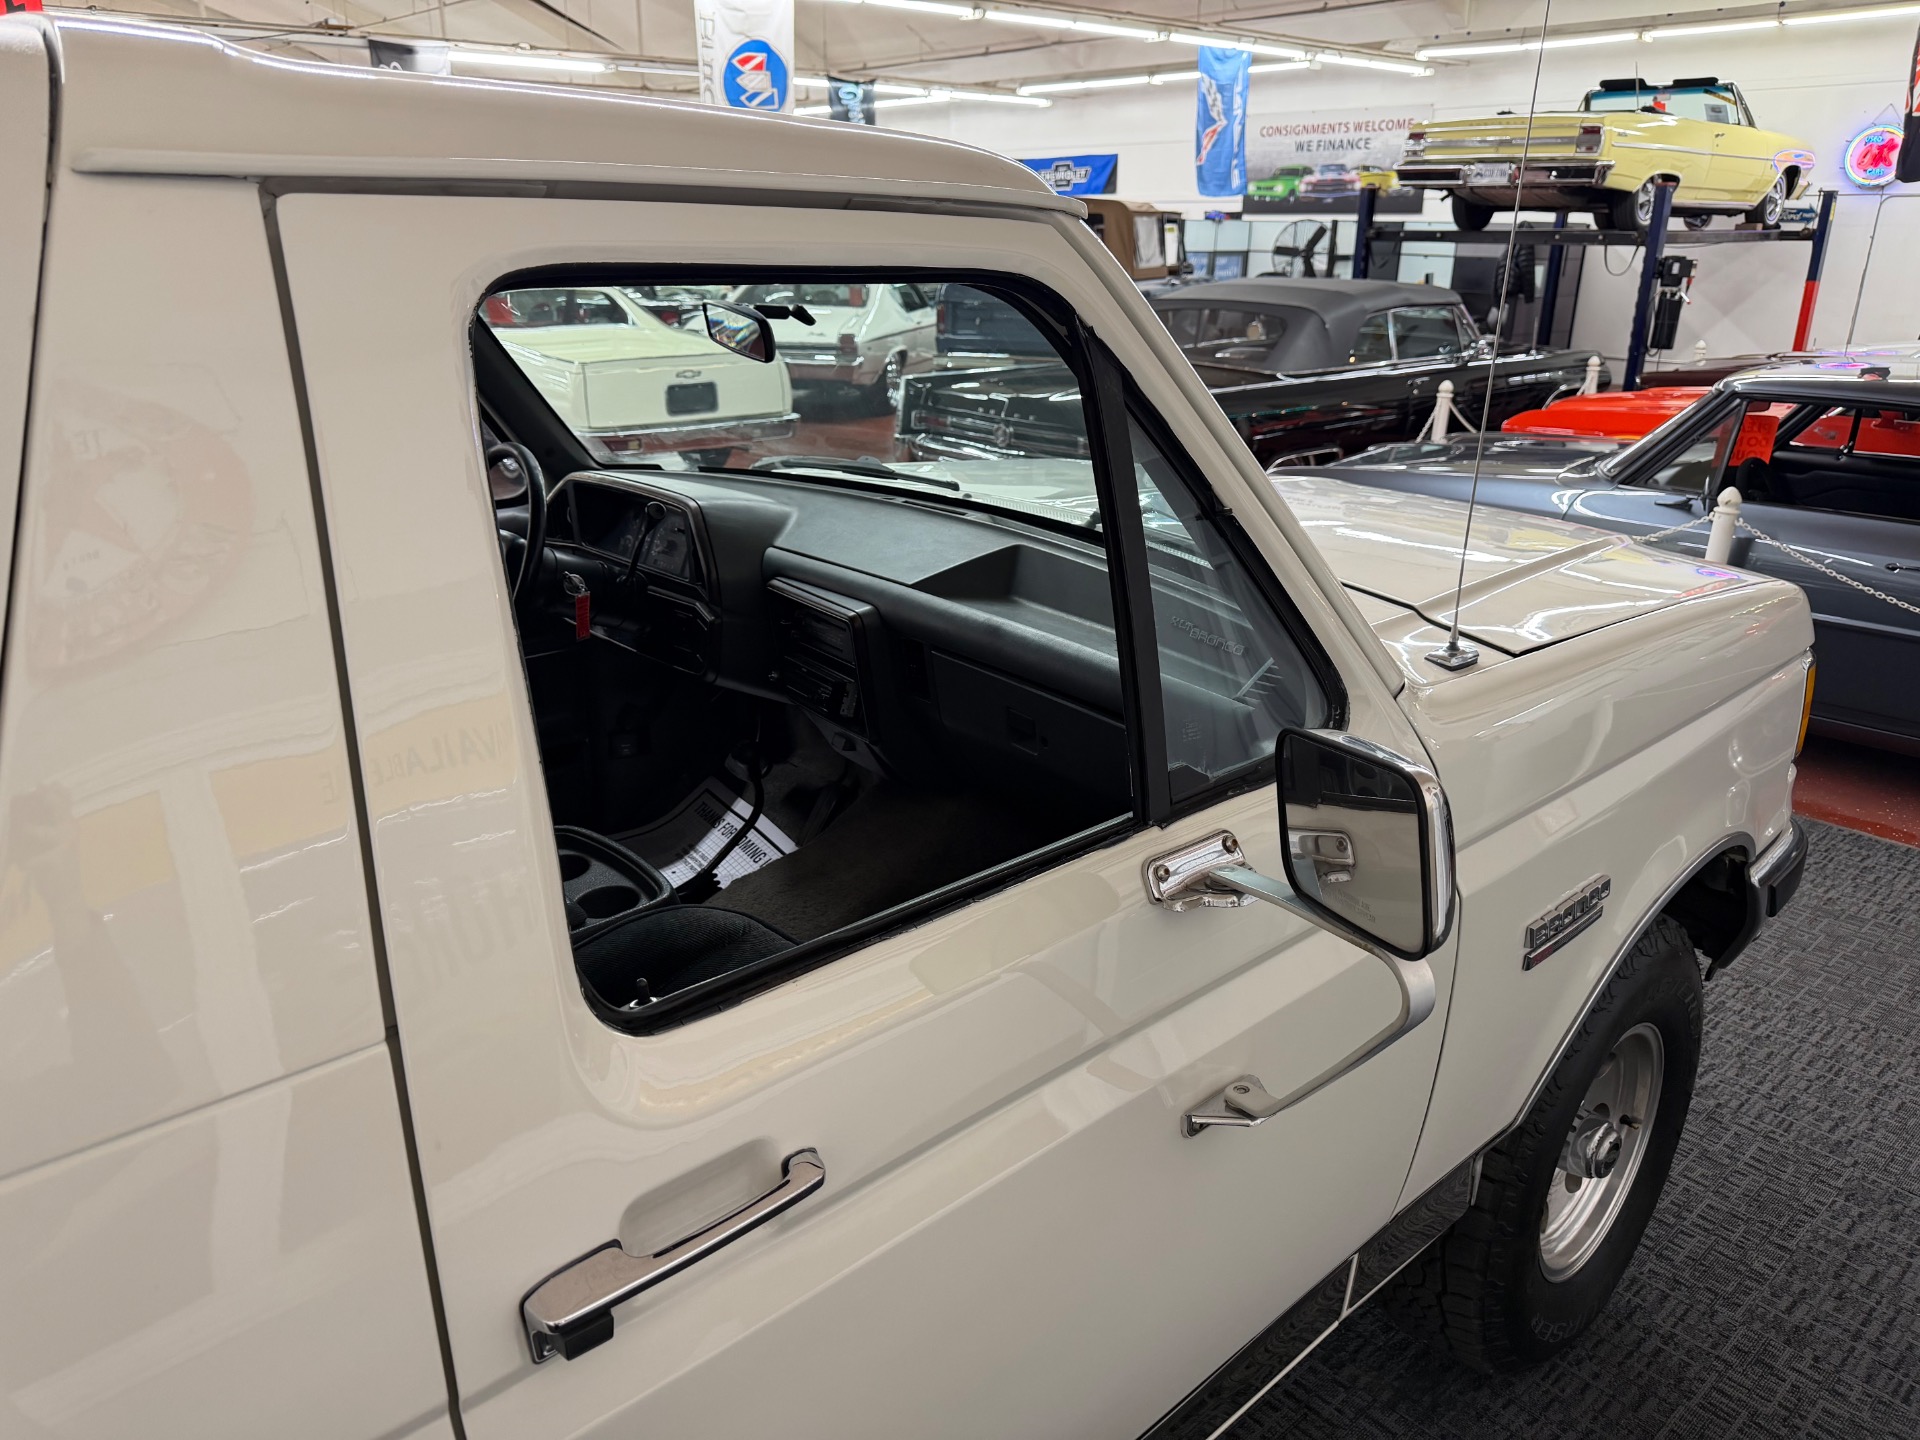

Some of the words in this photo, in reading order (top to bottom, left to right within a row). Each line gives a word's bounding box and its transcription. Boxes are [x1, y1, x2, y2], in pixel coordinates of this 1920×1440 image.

[1260, 121, 1350, 137] CONSIGNMENTS
[1353, 118, 1415, 132] WELCOME
[1295, 140, 1314, 152] WE
[1316, 138, 1372, 151] FINANCE
[1190, 627, 1245, 656] BRONCO
[694, 801, 726, 829] THANKS
[717, 821, 738, 839] FOR
[1525, 875, 1611, 948] BRONCO
